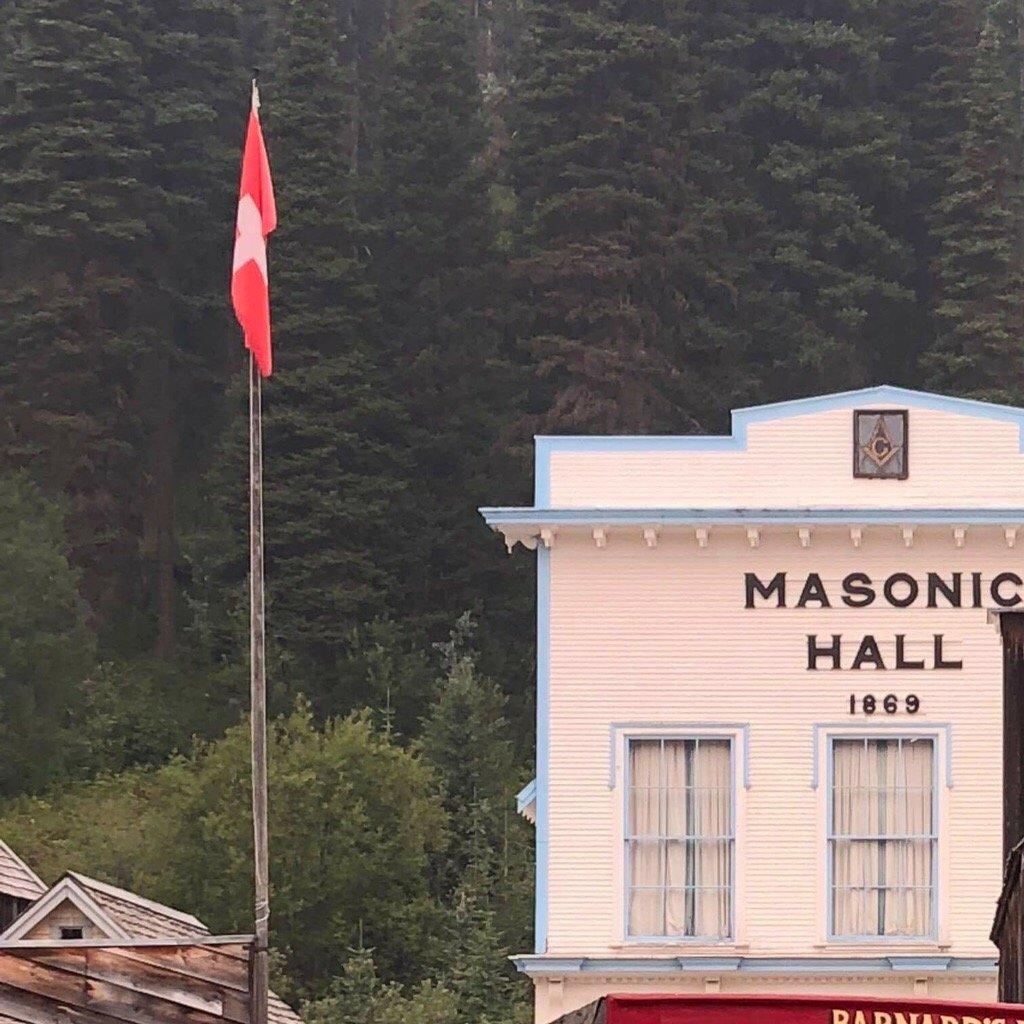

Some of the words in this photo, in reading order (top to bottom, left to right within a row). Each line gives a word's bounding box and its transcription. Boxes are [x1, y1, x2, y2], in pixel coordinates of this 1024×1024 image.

[744, 572, 1023, 609] MASONIC
[806, 634, 963, 670] HALL
[849, 694, 920, 715] 1869
